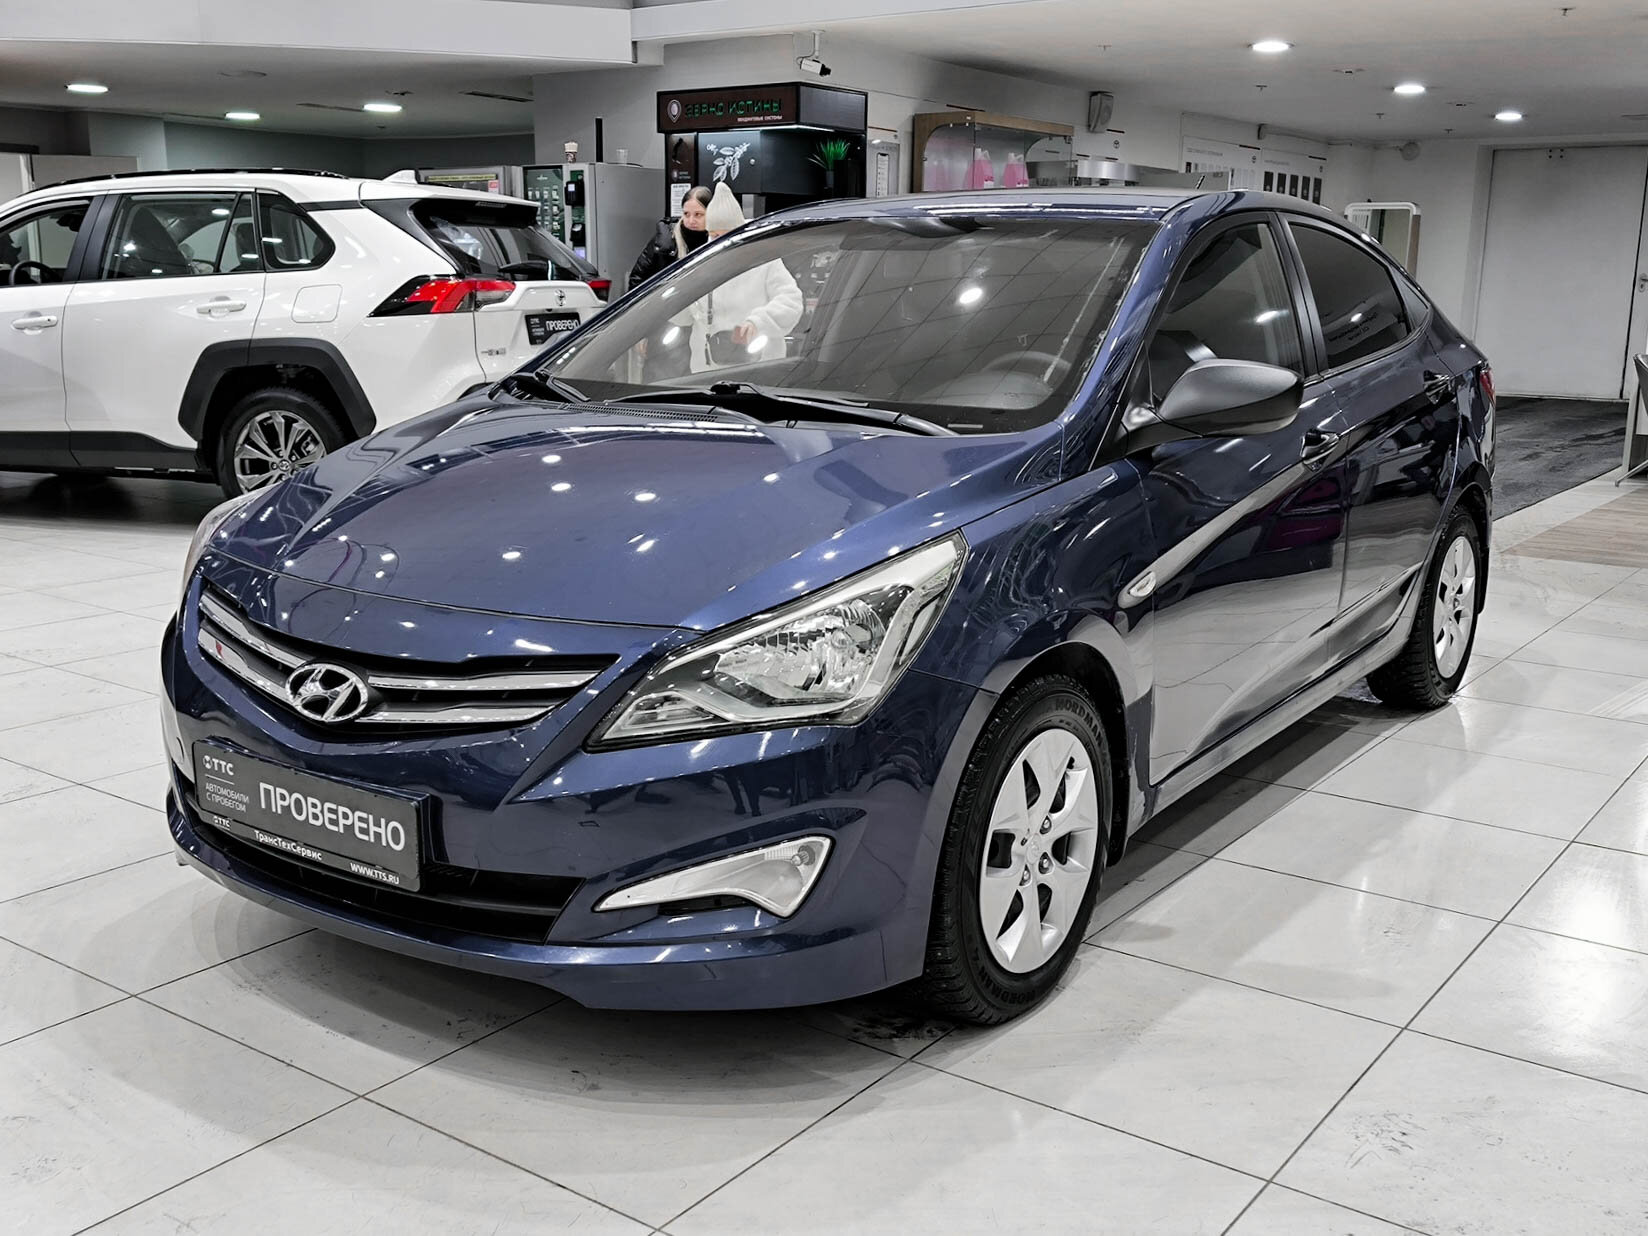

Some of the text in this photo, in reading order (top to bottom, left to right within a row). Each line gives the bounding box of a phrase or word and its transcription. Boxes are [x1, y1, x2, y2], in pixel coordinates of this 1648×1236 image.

[728, 99, 782, 115] ИСТИНЫ
[212, 758, 234, 776] ТТС
[205, 783, 250, 804] АВТОМОБИЛИ
[206, 792, 247, 813] С ПРОБЕГОМ
[259, 782, 406, 852] ПРОВЕРЕНО
[254, 830, 323, 861] ТрансТехСервис
[350, 862, 400, 885] WWW.TTS.RU
